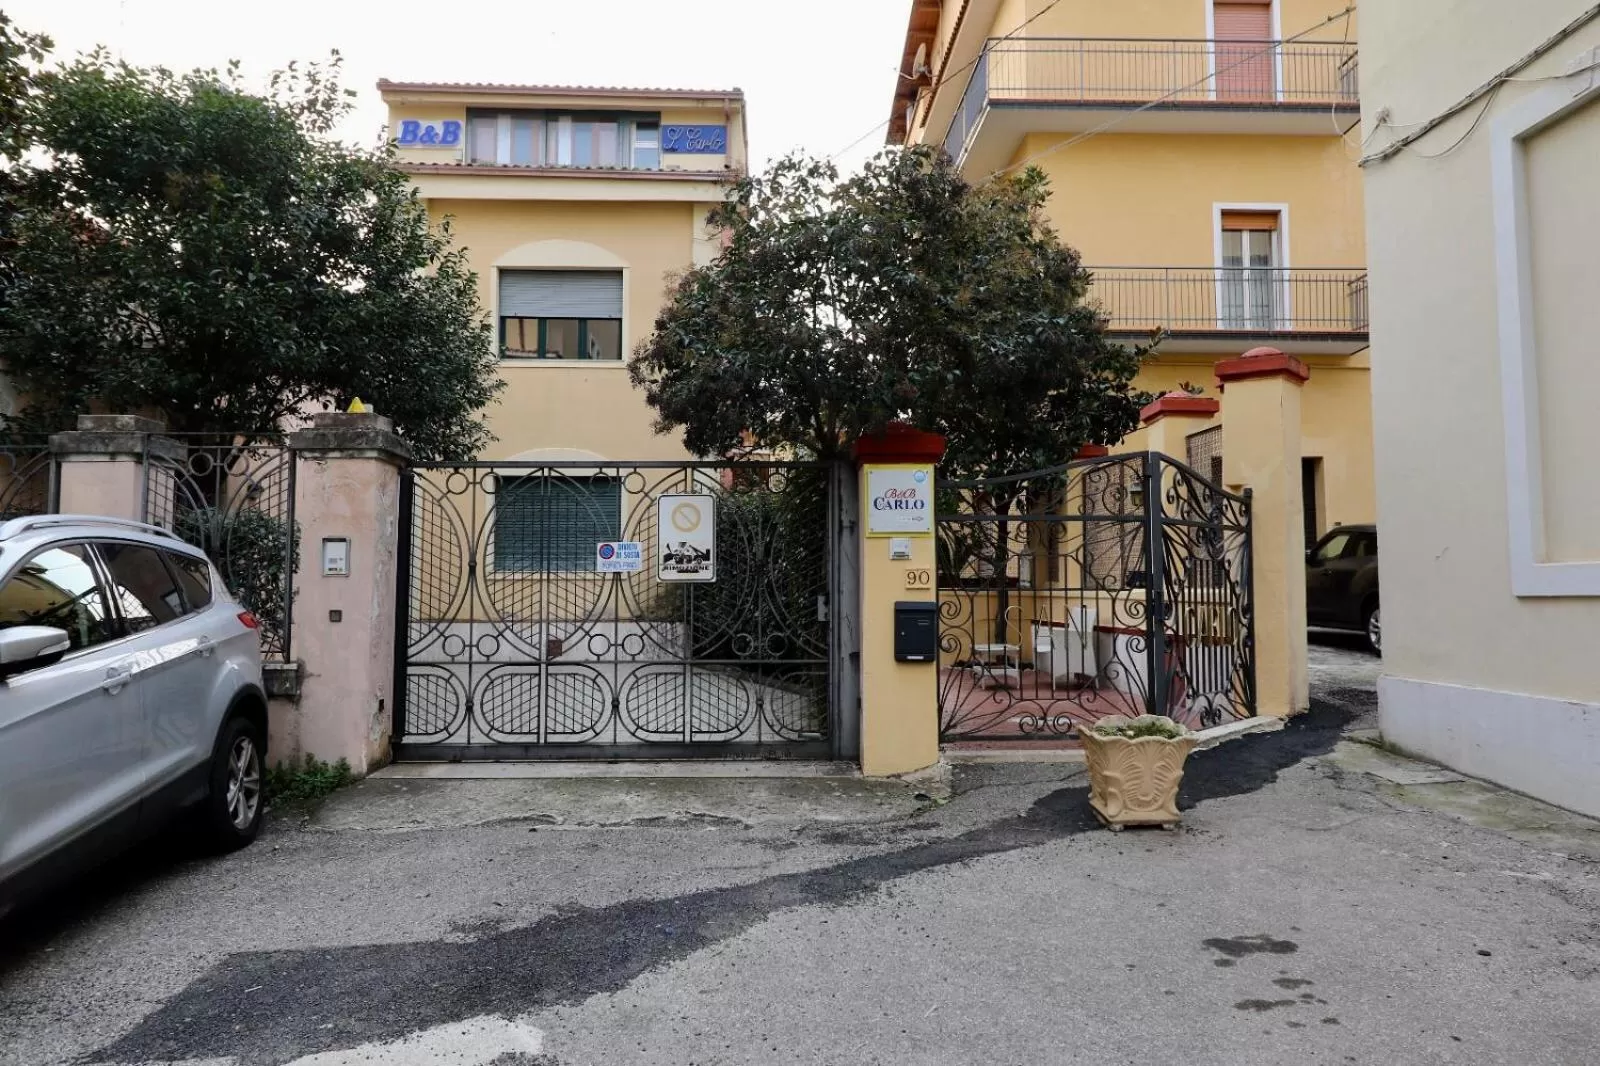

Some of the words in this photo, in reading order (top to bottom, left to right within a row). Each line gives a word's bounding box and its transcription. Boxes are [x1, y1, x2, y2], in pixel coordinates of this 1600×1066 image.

[398, 121, 461, 144] B&B
[686, 127, 724, 150] Carlo
[873, 497, 925, 511] CARLO
[624, 551, 640, 559] SOSTA
[907, 571, 930, 585] 90
